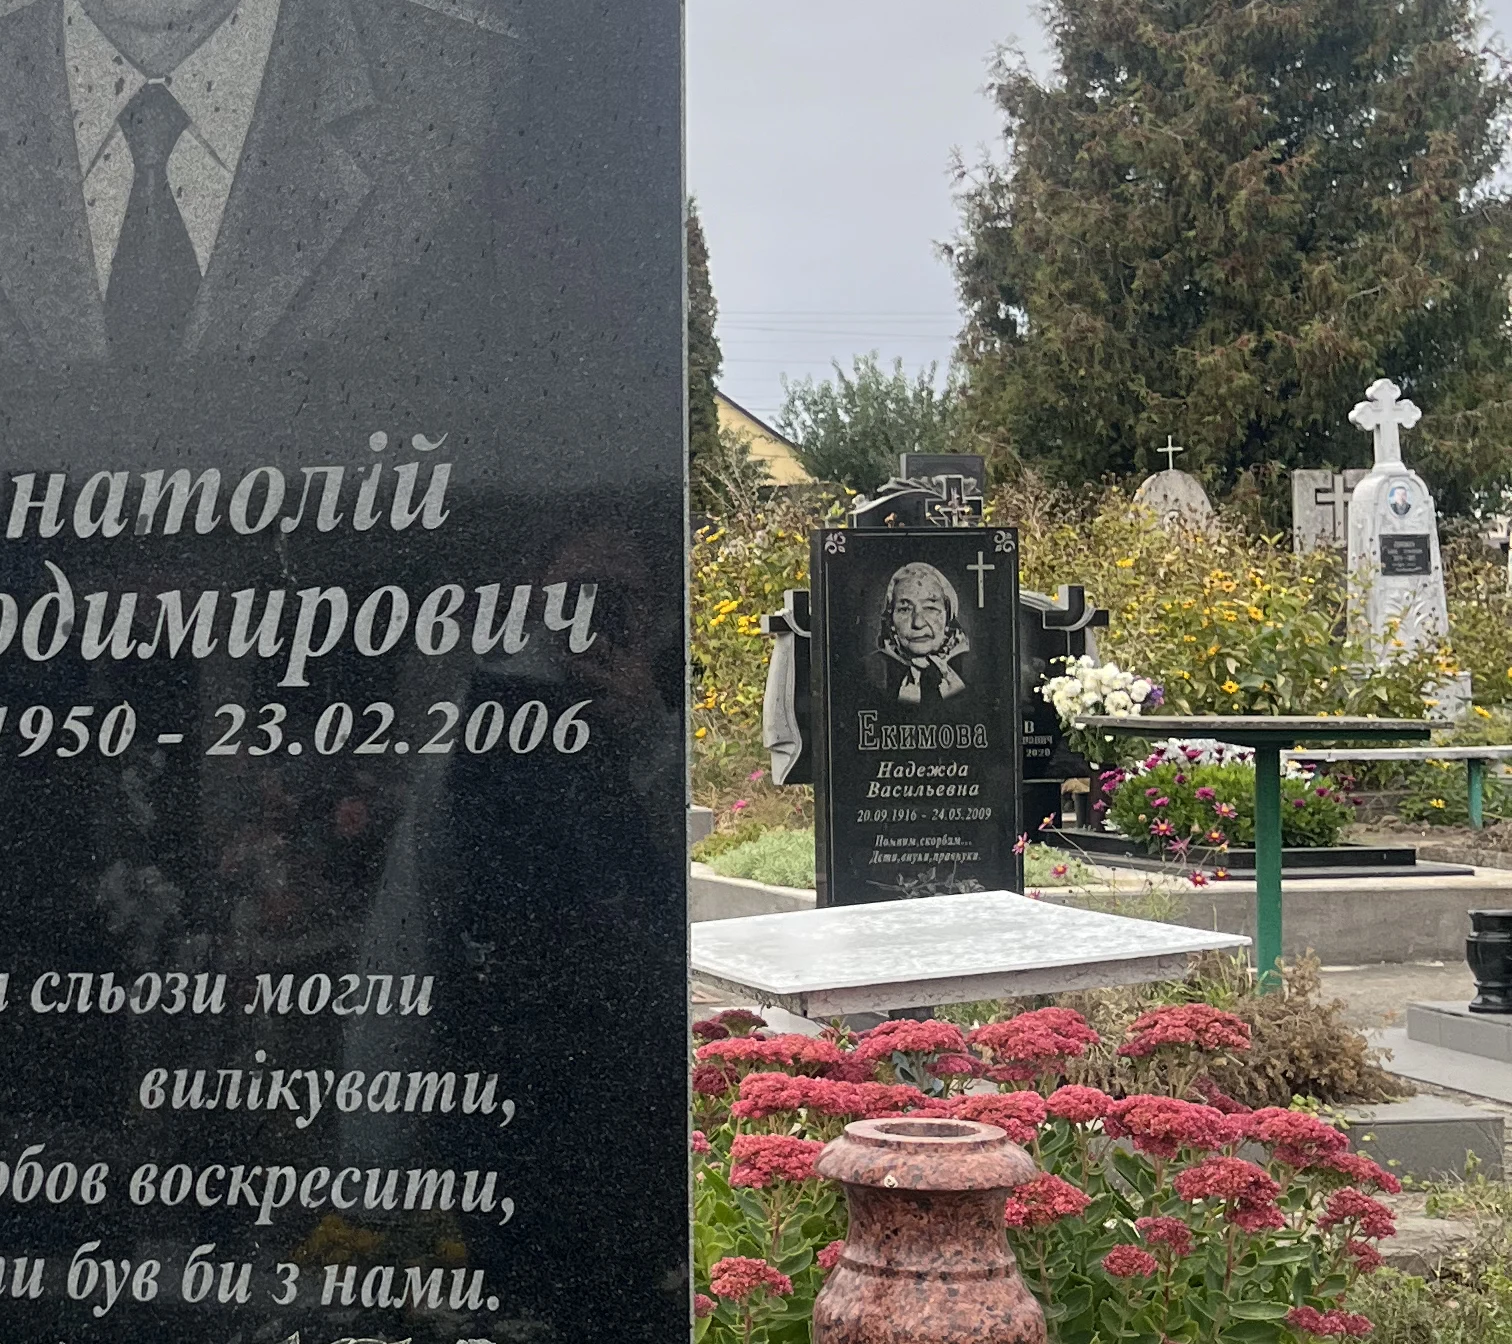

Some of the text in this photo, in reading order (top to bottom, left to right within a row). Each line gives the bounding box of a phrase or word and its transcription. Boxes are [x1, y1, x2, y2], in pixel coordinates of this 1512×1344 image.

[204, 698, 593, 757] 23.02.2006
[856, 708, 990, 752] Екимова
[866, 781, 980, 798] Васильевна
[876, 760, 969, 779] Надежда
[29, 970, 228, 1016] сльози
[243, 972, 435, 1017] могли
[138, 1048, 516, 1131] вилікувати,
[128, 1162, 516, 1227] воскресити,
[65, 1239, 163, 1319] був
[180, 1242, 254, 1305] би
[270, 1261, 301, 1306] з
[319, 1262, 501, 1312] нами.
